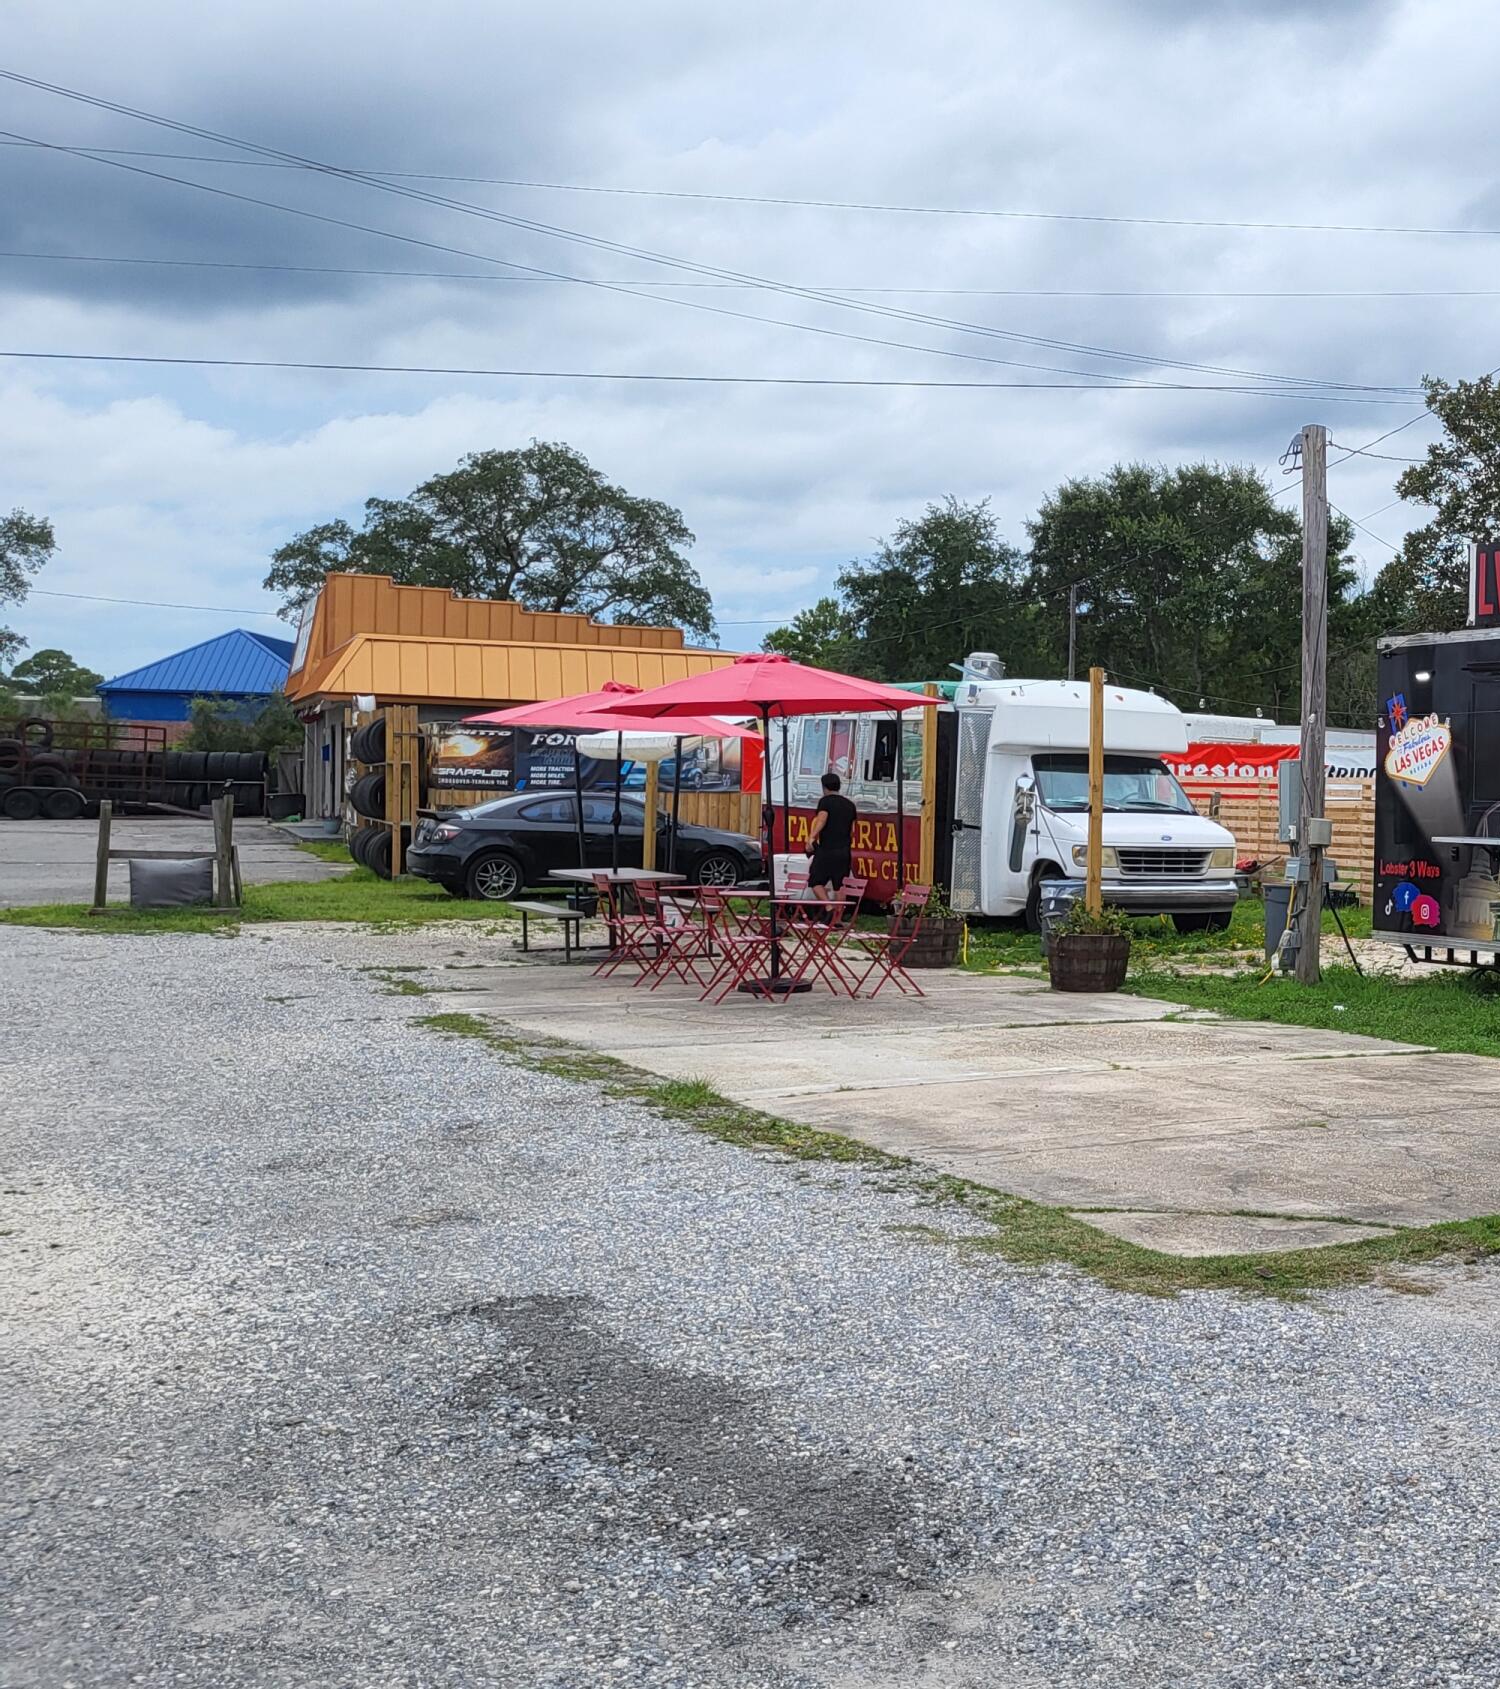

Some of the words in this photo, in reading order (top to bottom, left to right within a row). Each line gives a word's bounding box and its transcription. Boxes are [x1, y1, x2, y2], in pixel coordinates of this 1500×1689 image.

[1390, 714, 1438, 748] WELCOME
[1394, 753, 1412, 773] LAS
[1412, 736, 1445, 764] VEGAS
[788, 815, 898, 852] TARIA
[858, 858, 877, 877] AL
[1380, 859, 1408, 876] Lobster
[1409, 860, 1416, 877] 3
[1417, 861, 1440, 878] Ways
